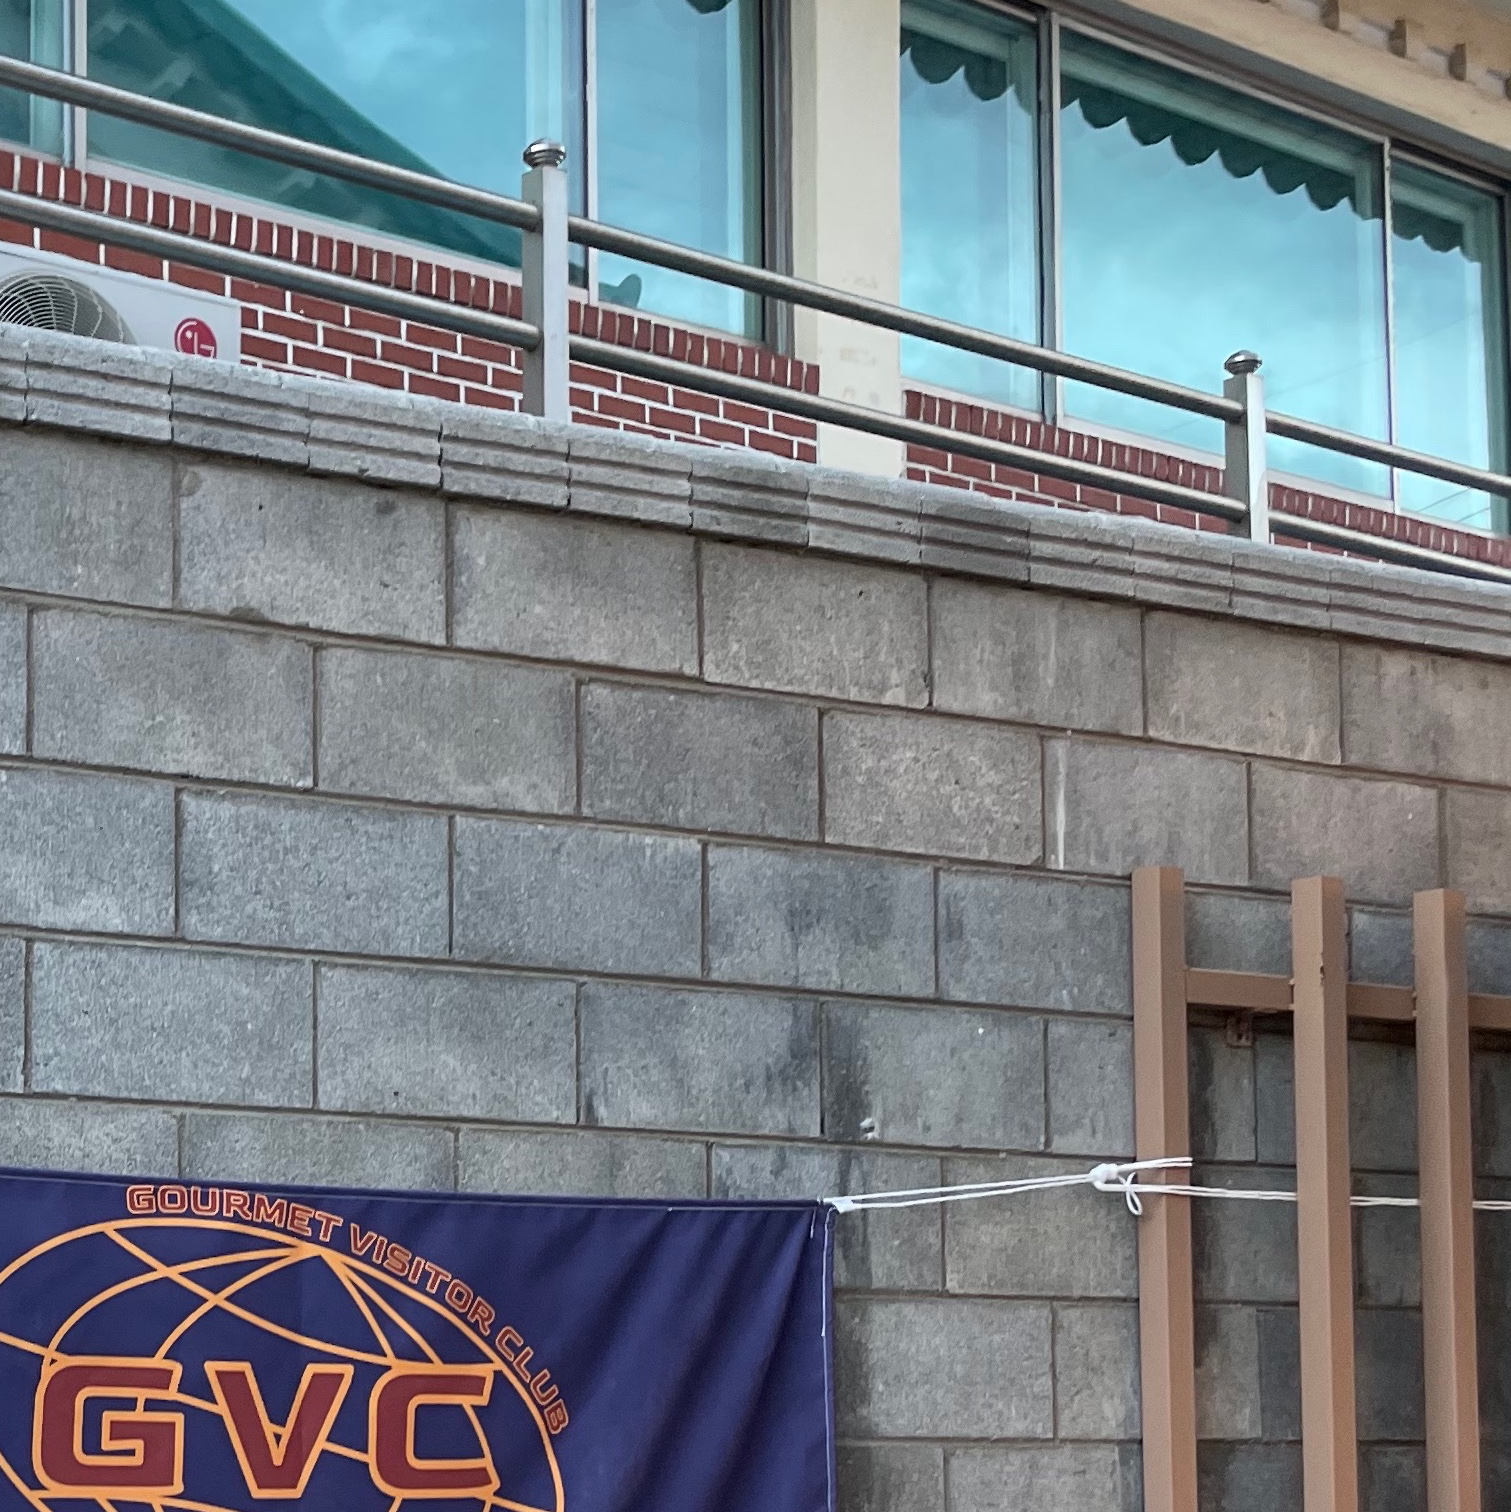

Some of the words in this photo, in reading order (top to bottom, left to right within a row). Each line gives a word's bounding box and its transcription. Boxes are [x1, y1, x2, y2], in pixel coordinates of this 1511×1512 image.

[126, 1184, 343, 1242] GOURMET
[350, 1223, 496, 1336] VISITOR
[495, 1325, 569, 1435] CLUB
[32, 1356, 501, 1499] GVC
